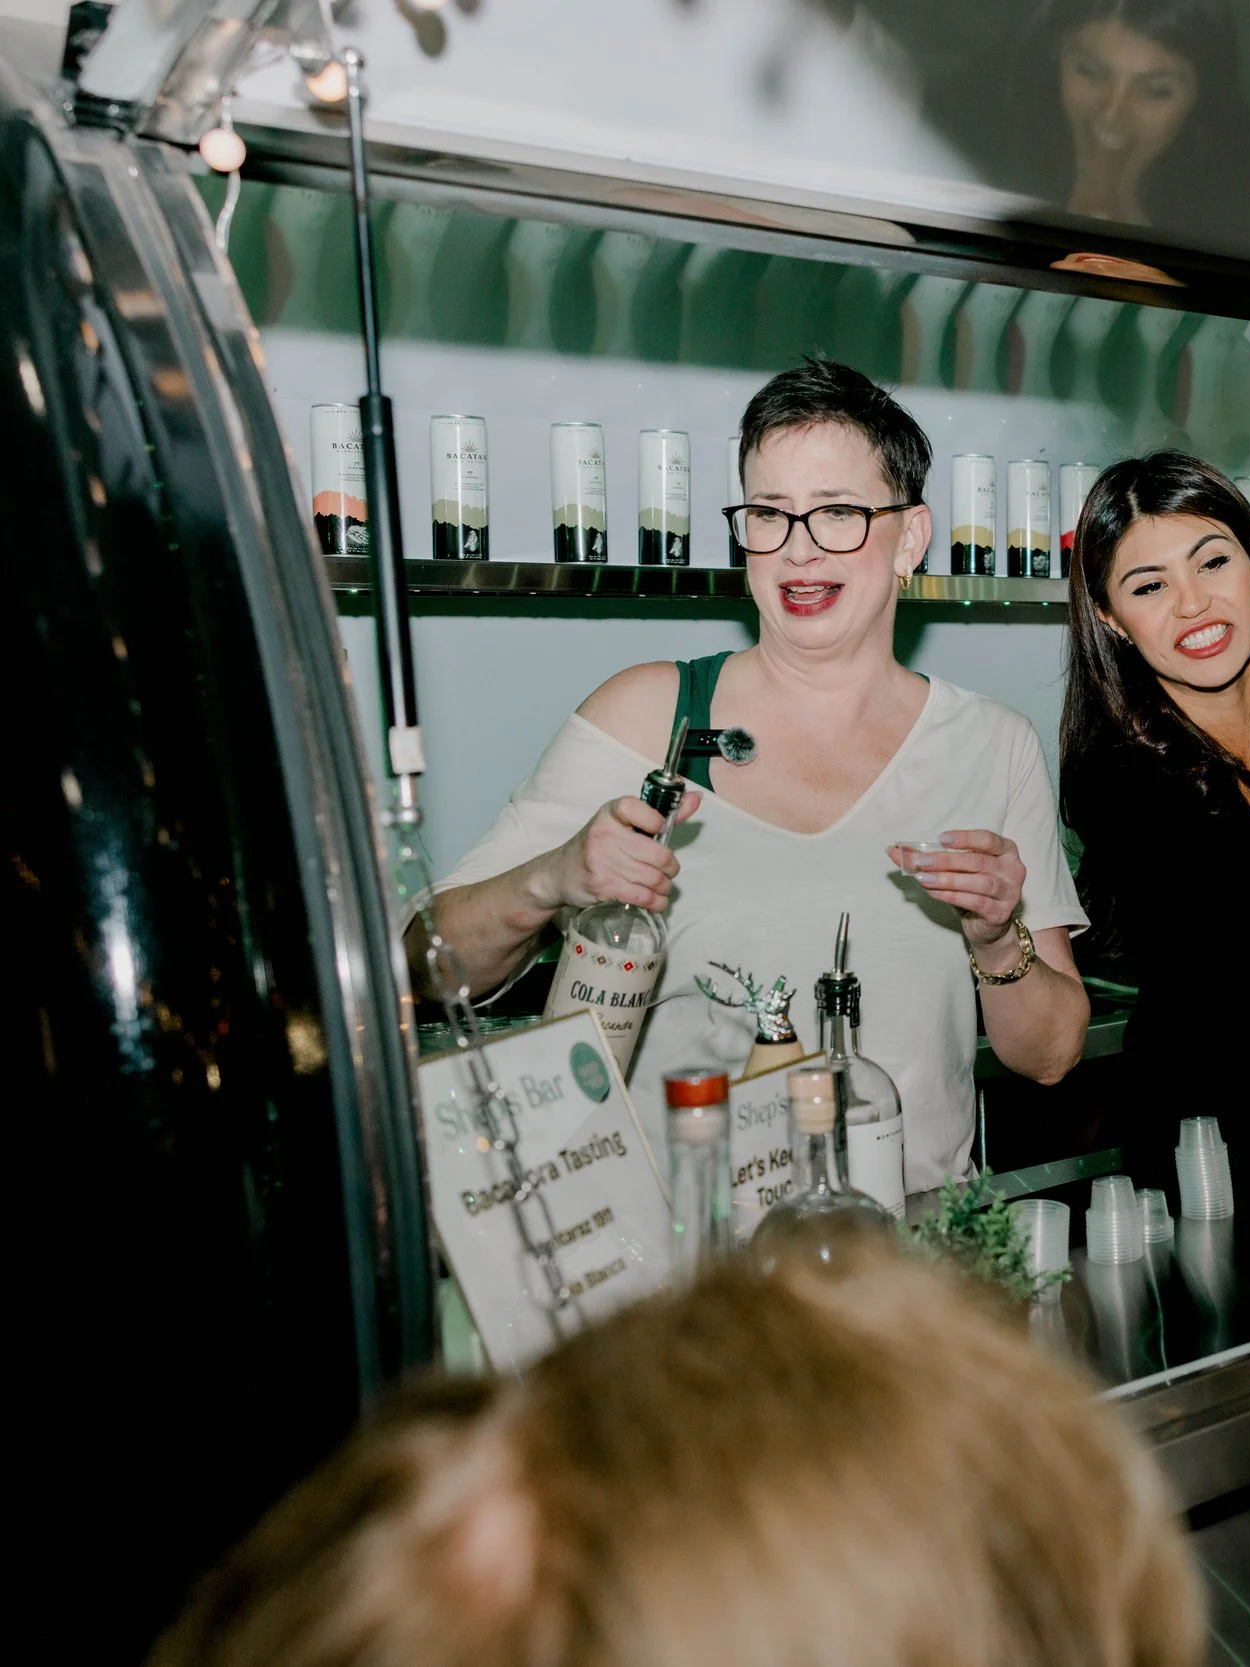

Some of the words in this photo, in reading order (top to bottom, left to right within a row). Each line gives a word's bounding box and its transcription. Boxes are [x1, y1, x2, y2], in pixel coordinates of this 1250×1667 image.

[570, 980, 605, 1005] COLA
[520, 1070, 565, 1110] Bar
[557, 1128, 628, 1174] Tasting
